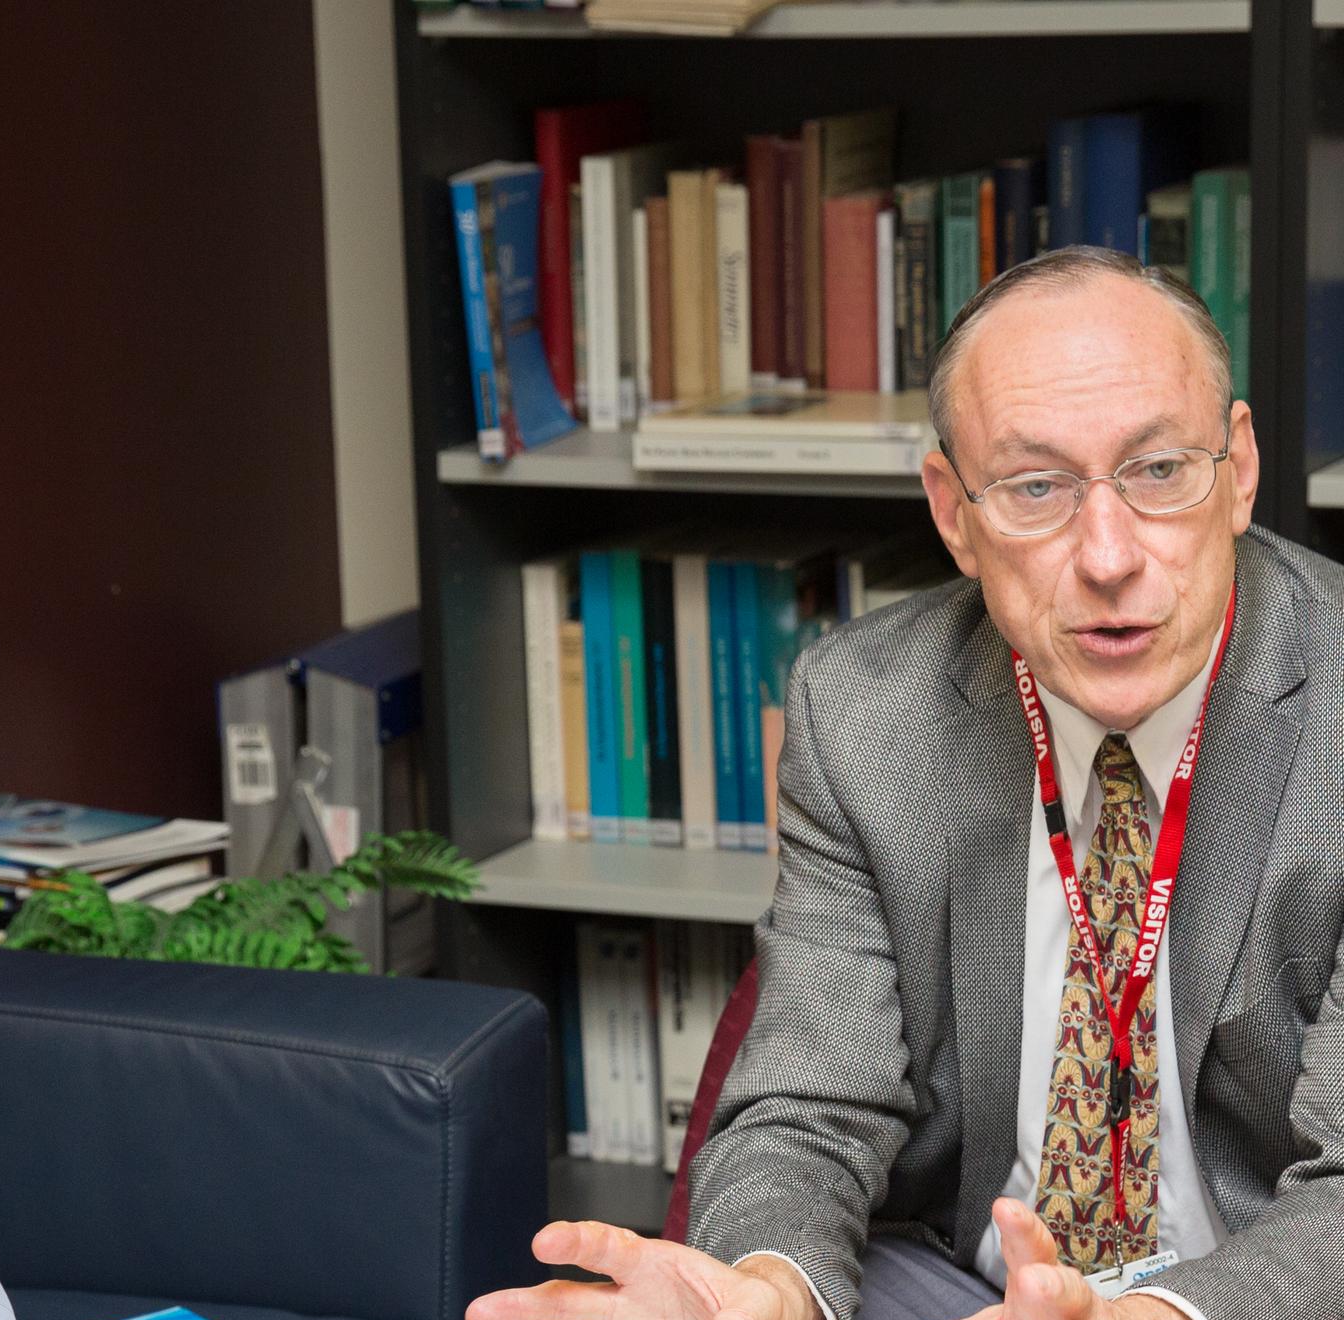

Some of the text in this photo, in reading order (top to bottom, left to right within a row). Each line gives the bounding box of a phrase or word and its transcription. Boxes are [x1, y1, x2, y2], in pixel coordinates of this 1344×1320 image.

[1015, 658, 1049, 761] VISITOR
[1064, 874, 1102, 975] VISITOR
[1132, 878, 1172, 978] VISITOR
